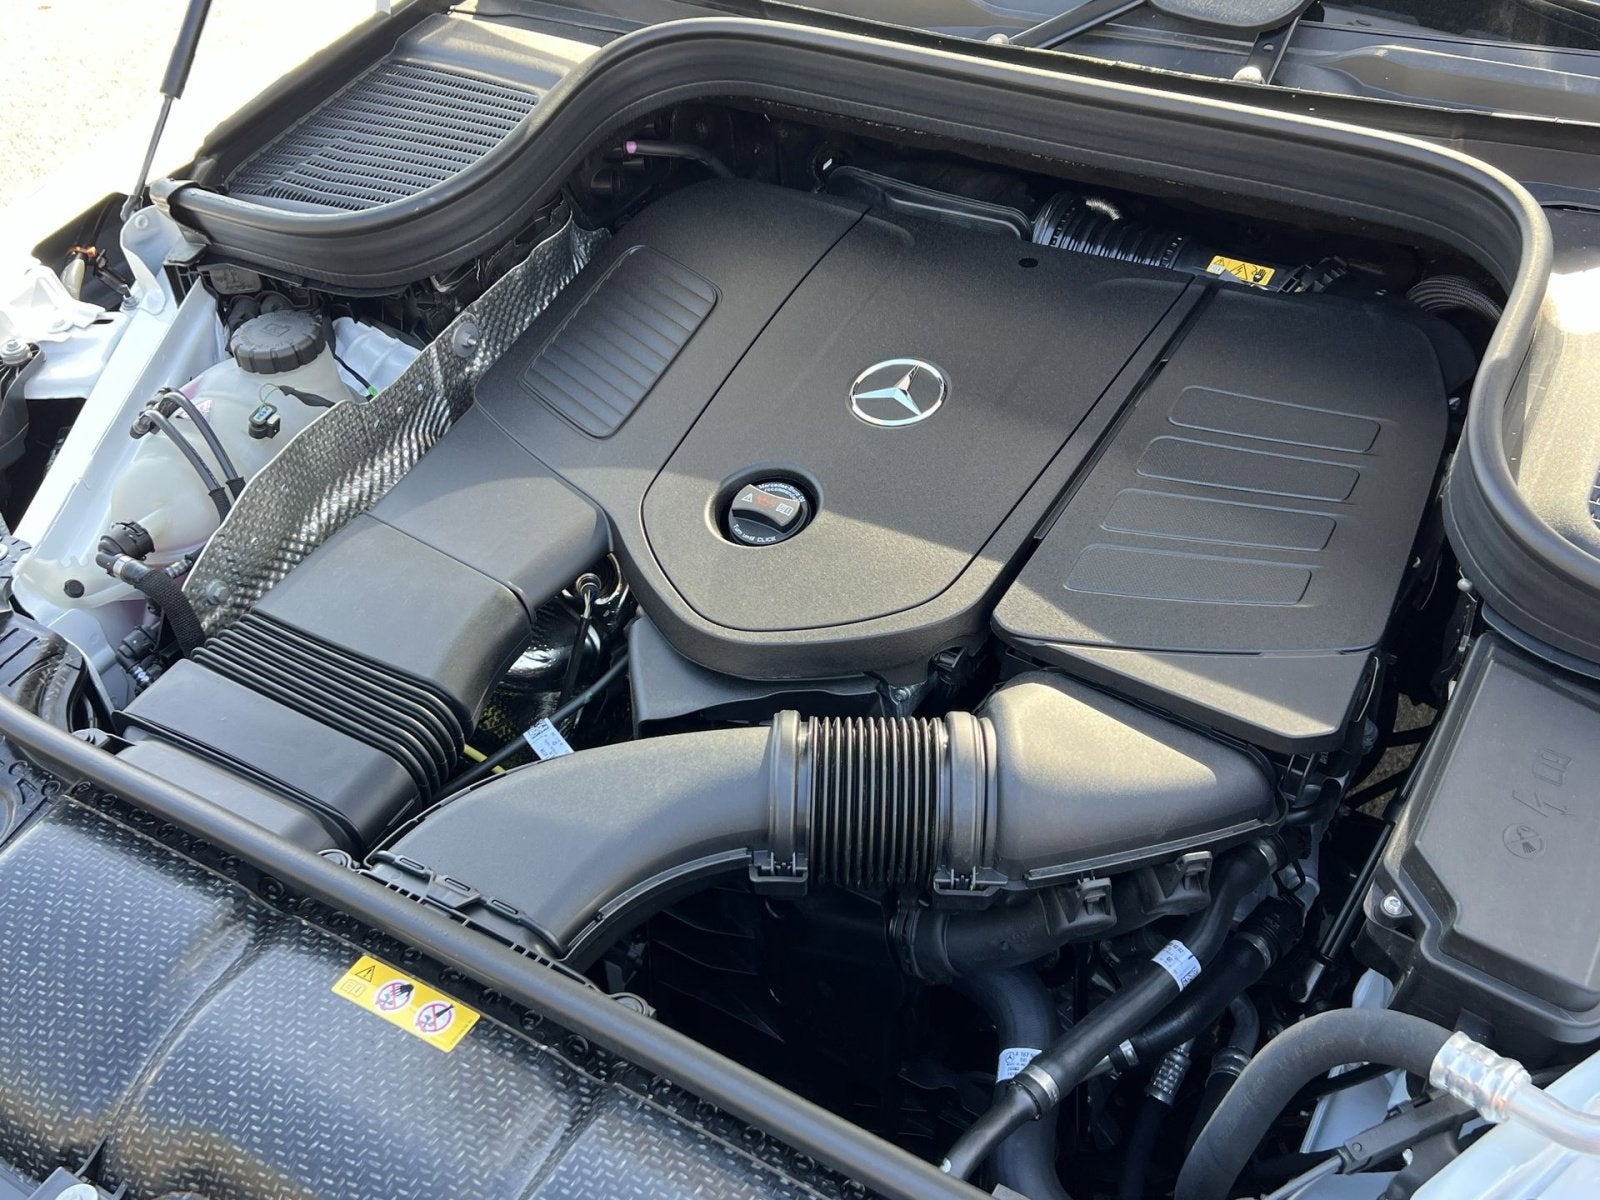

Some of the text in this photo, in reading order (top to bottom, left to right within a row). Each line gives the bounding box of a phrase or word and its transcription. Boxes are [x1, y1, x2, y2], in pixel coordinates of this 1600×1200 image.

[758, 483, 800, 496] Mercedes-Benz
[733, 524, 743, 535] Turn
[742, 533, 756, 541] until
